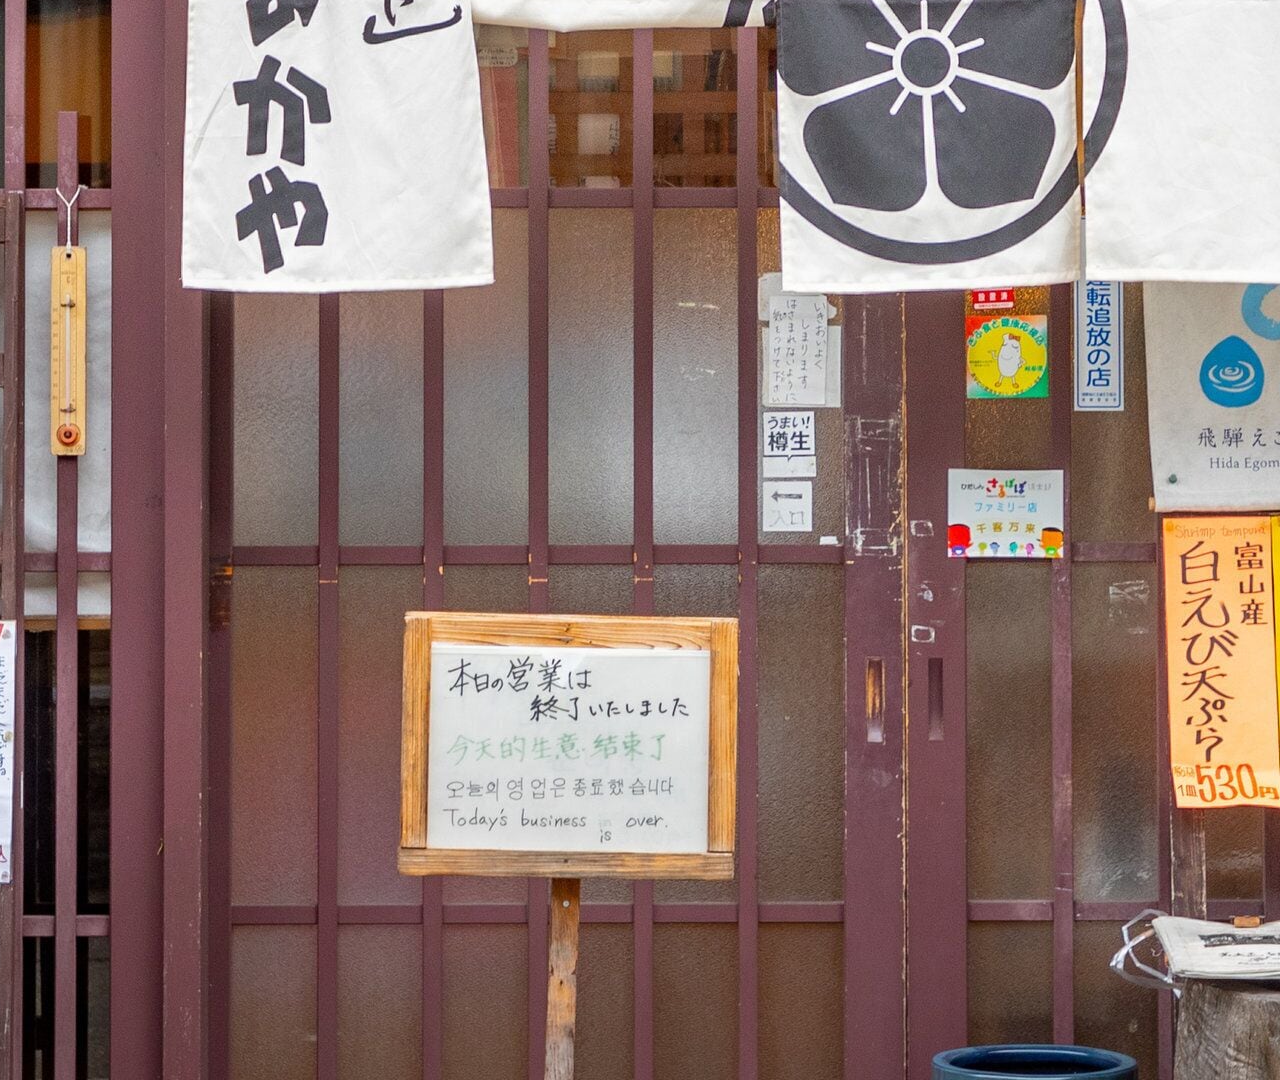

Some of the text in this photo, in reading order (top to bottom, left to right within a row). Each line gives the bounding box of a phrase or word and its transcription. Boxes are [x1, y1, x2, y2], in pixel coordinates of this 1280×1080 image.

[1086, 280, 1111, 387] 転追放の店
[767, 415, 811, 430] うまい!
[767, 430, 812, 452] 樽生
[1209, 456, 1240, 469] Hida
[768, 509, 805, 528] 入口
[974, 502, 1037, 513] ファミリー店
[976, 521, 1036, 534] 千客万来
[1175, 525, 1266, 539] Shrimp tempura
[1234, 541, 1268, 626] 富山産
[1179, 540, 1239, 763] 白えび天ぷら
[447, 655, 592, 697] 本日の営業は
[528, 695, 690, 723] 終了いたしました
[446, 777, 500, 802] 오늘의
[1195, 763, 1280, 803] 530円
[442, 807, 508, 835] Today's
[520, 808, 587, 828] business
[599, 829, 612, 843] is
